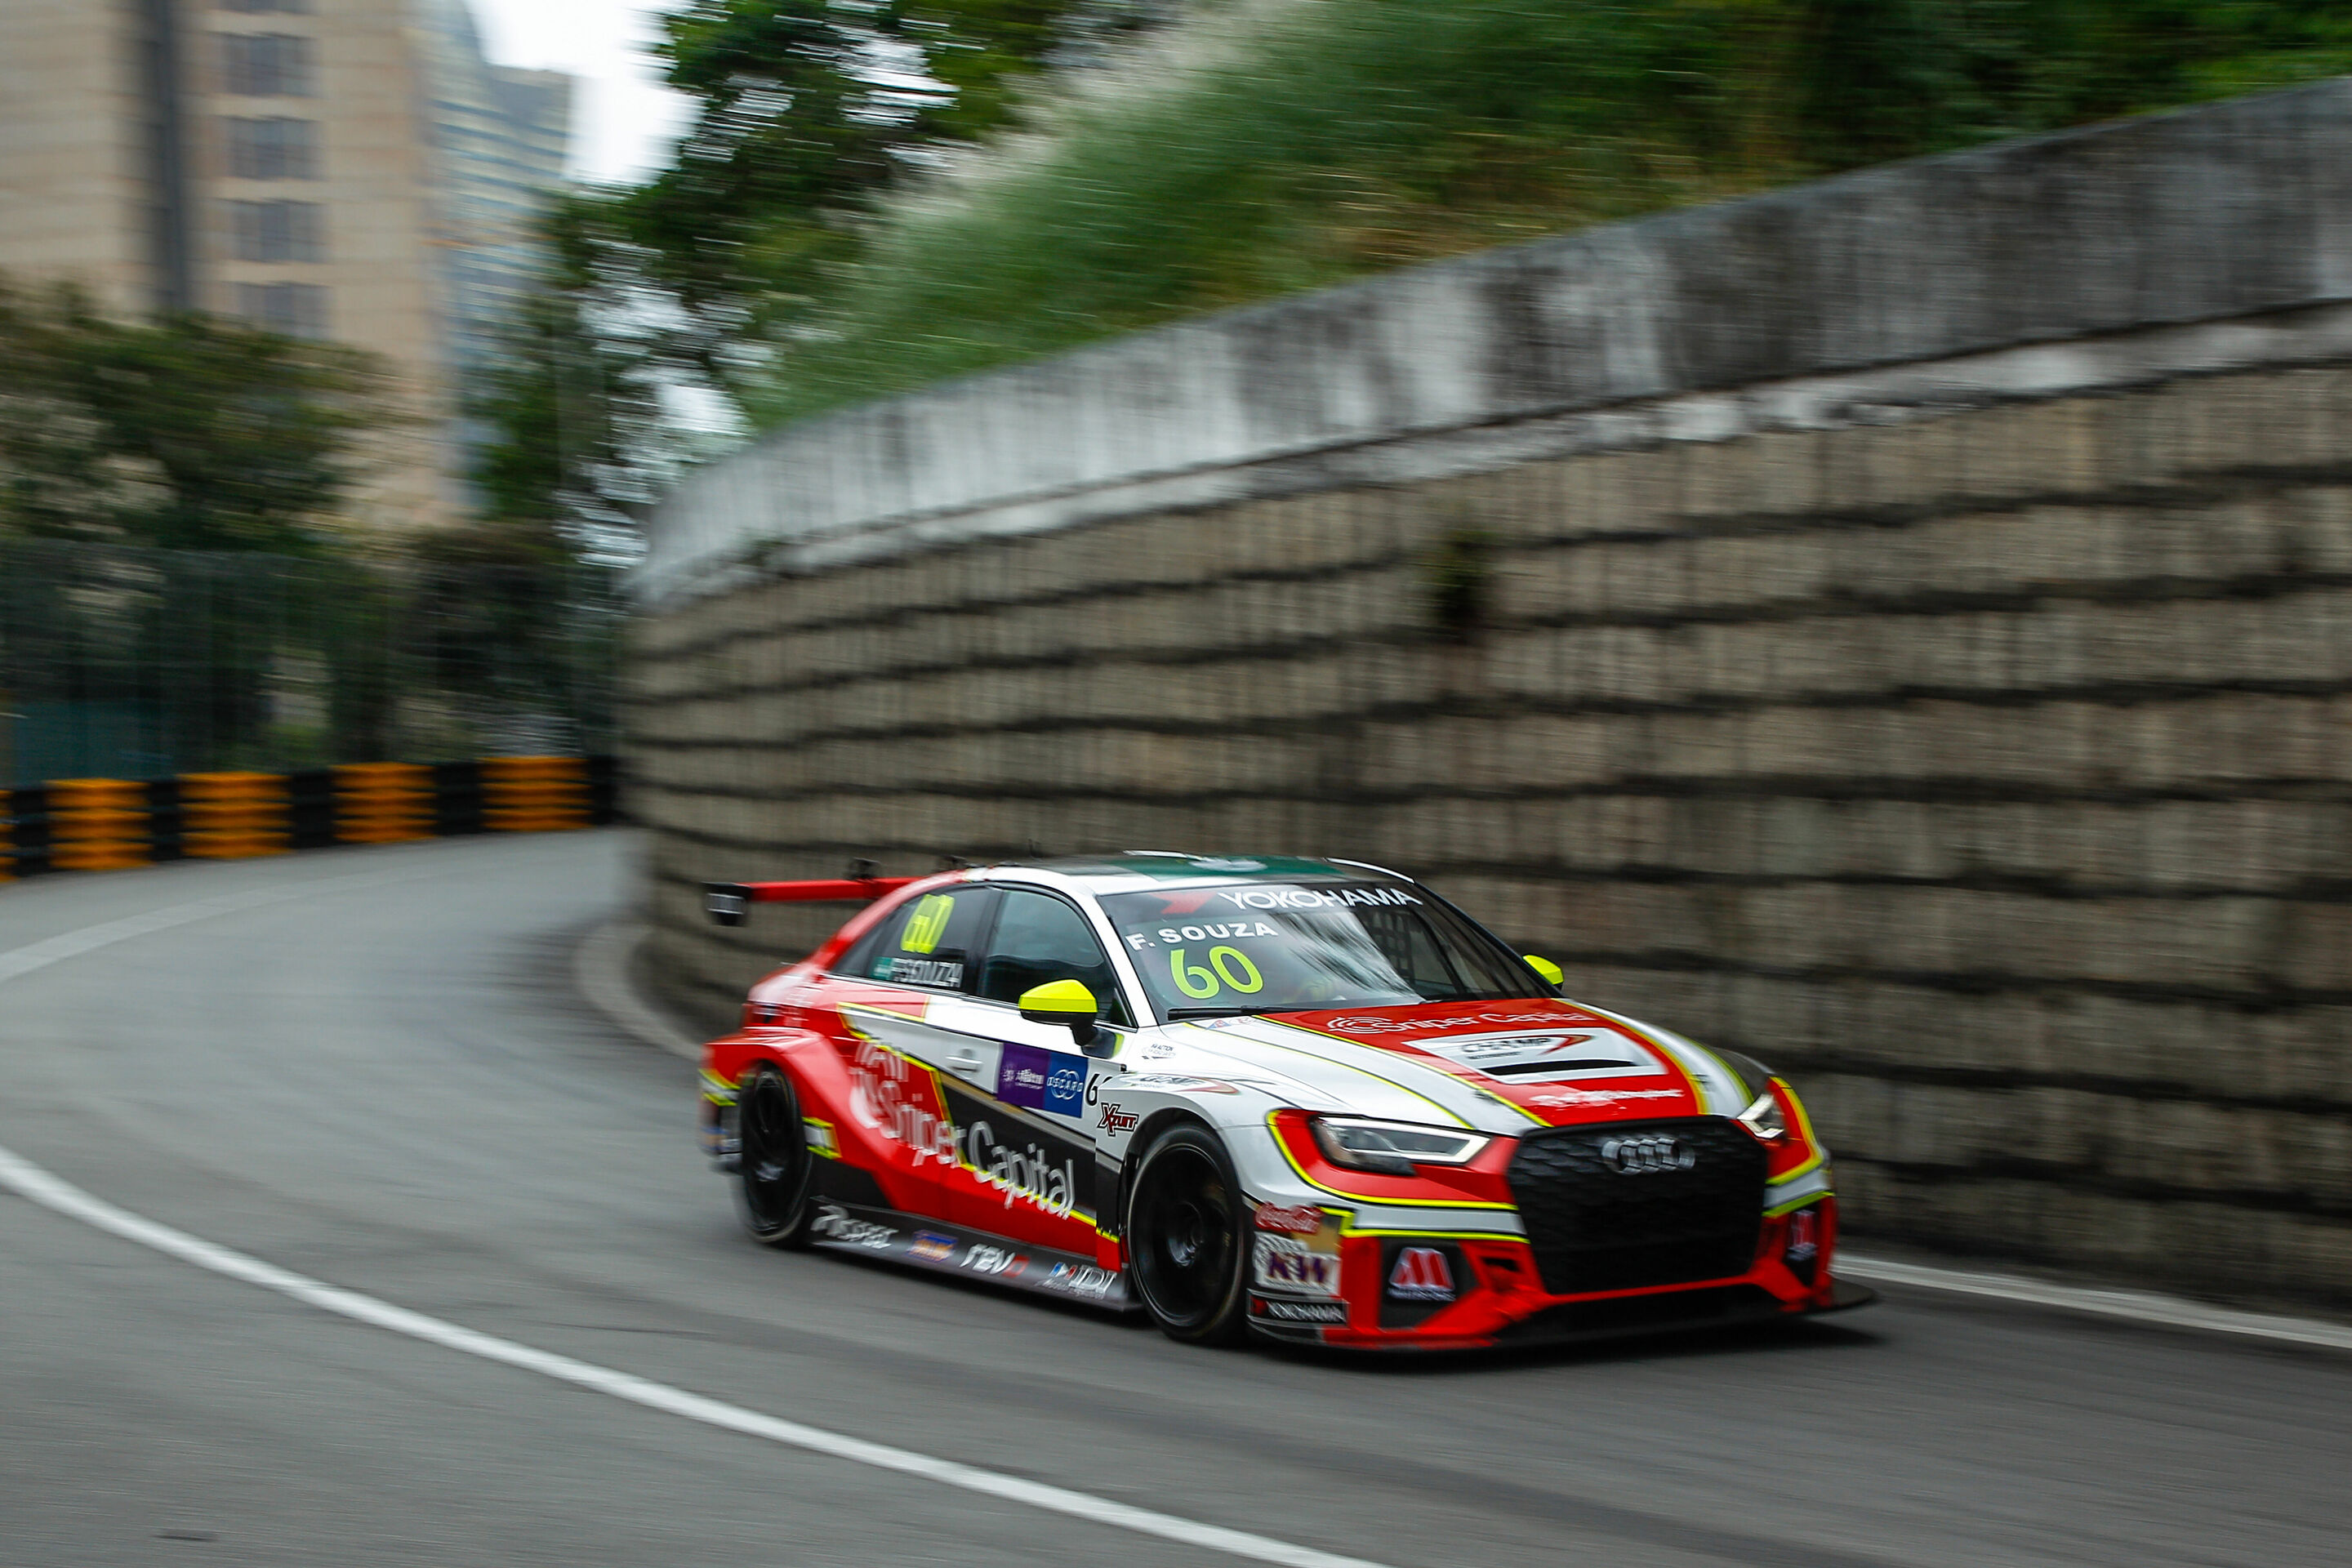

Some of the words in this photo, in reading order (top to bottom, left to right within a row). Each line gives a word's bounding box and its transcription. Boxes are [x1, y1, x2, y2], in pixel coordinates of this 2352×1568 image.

[1217, 887, 1423, 911] YOKOHAMA
[1125, 933, 1156, 951] F.
[1157, 922, 1279, 944] SOUZA
[1169, 945, 1264, 1000] 60
[1372, 1016, 1481, 1032] Sniper
[877, 1080, 967, 1169] Sniper
[969, 1120, 1076, 1221] Capital
